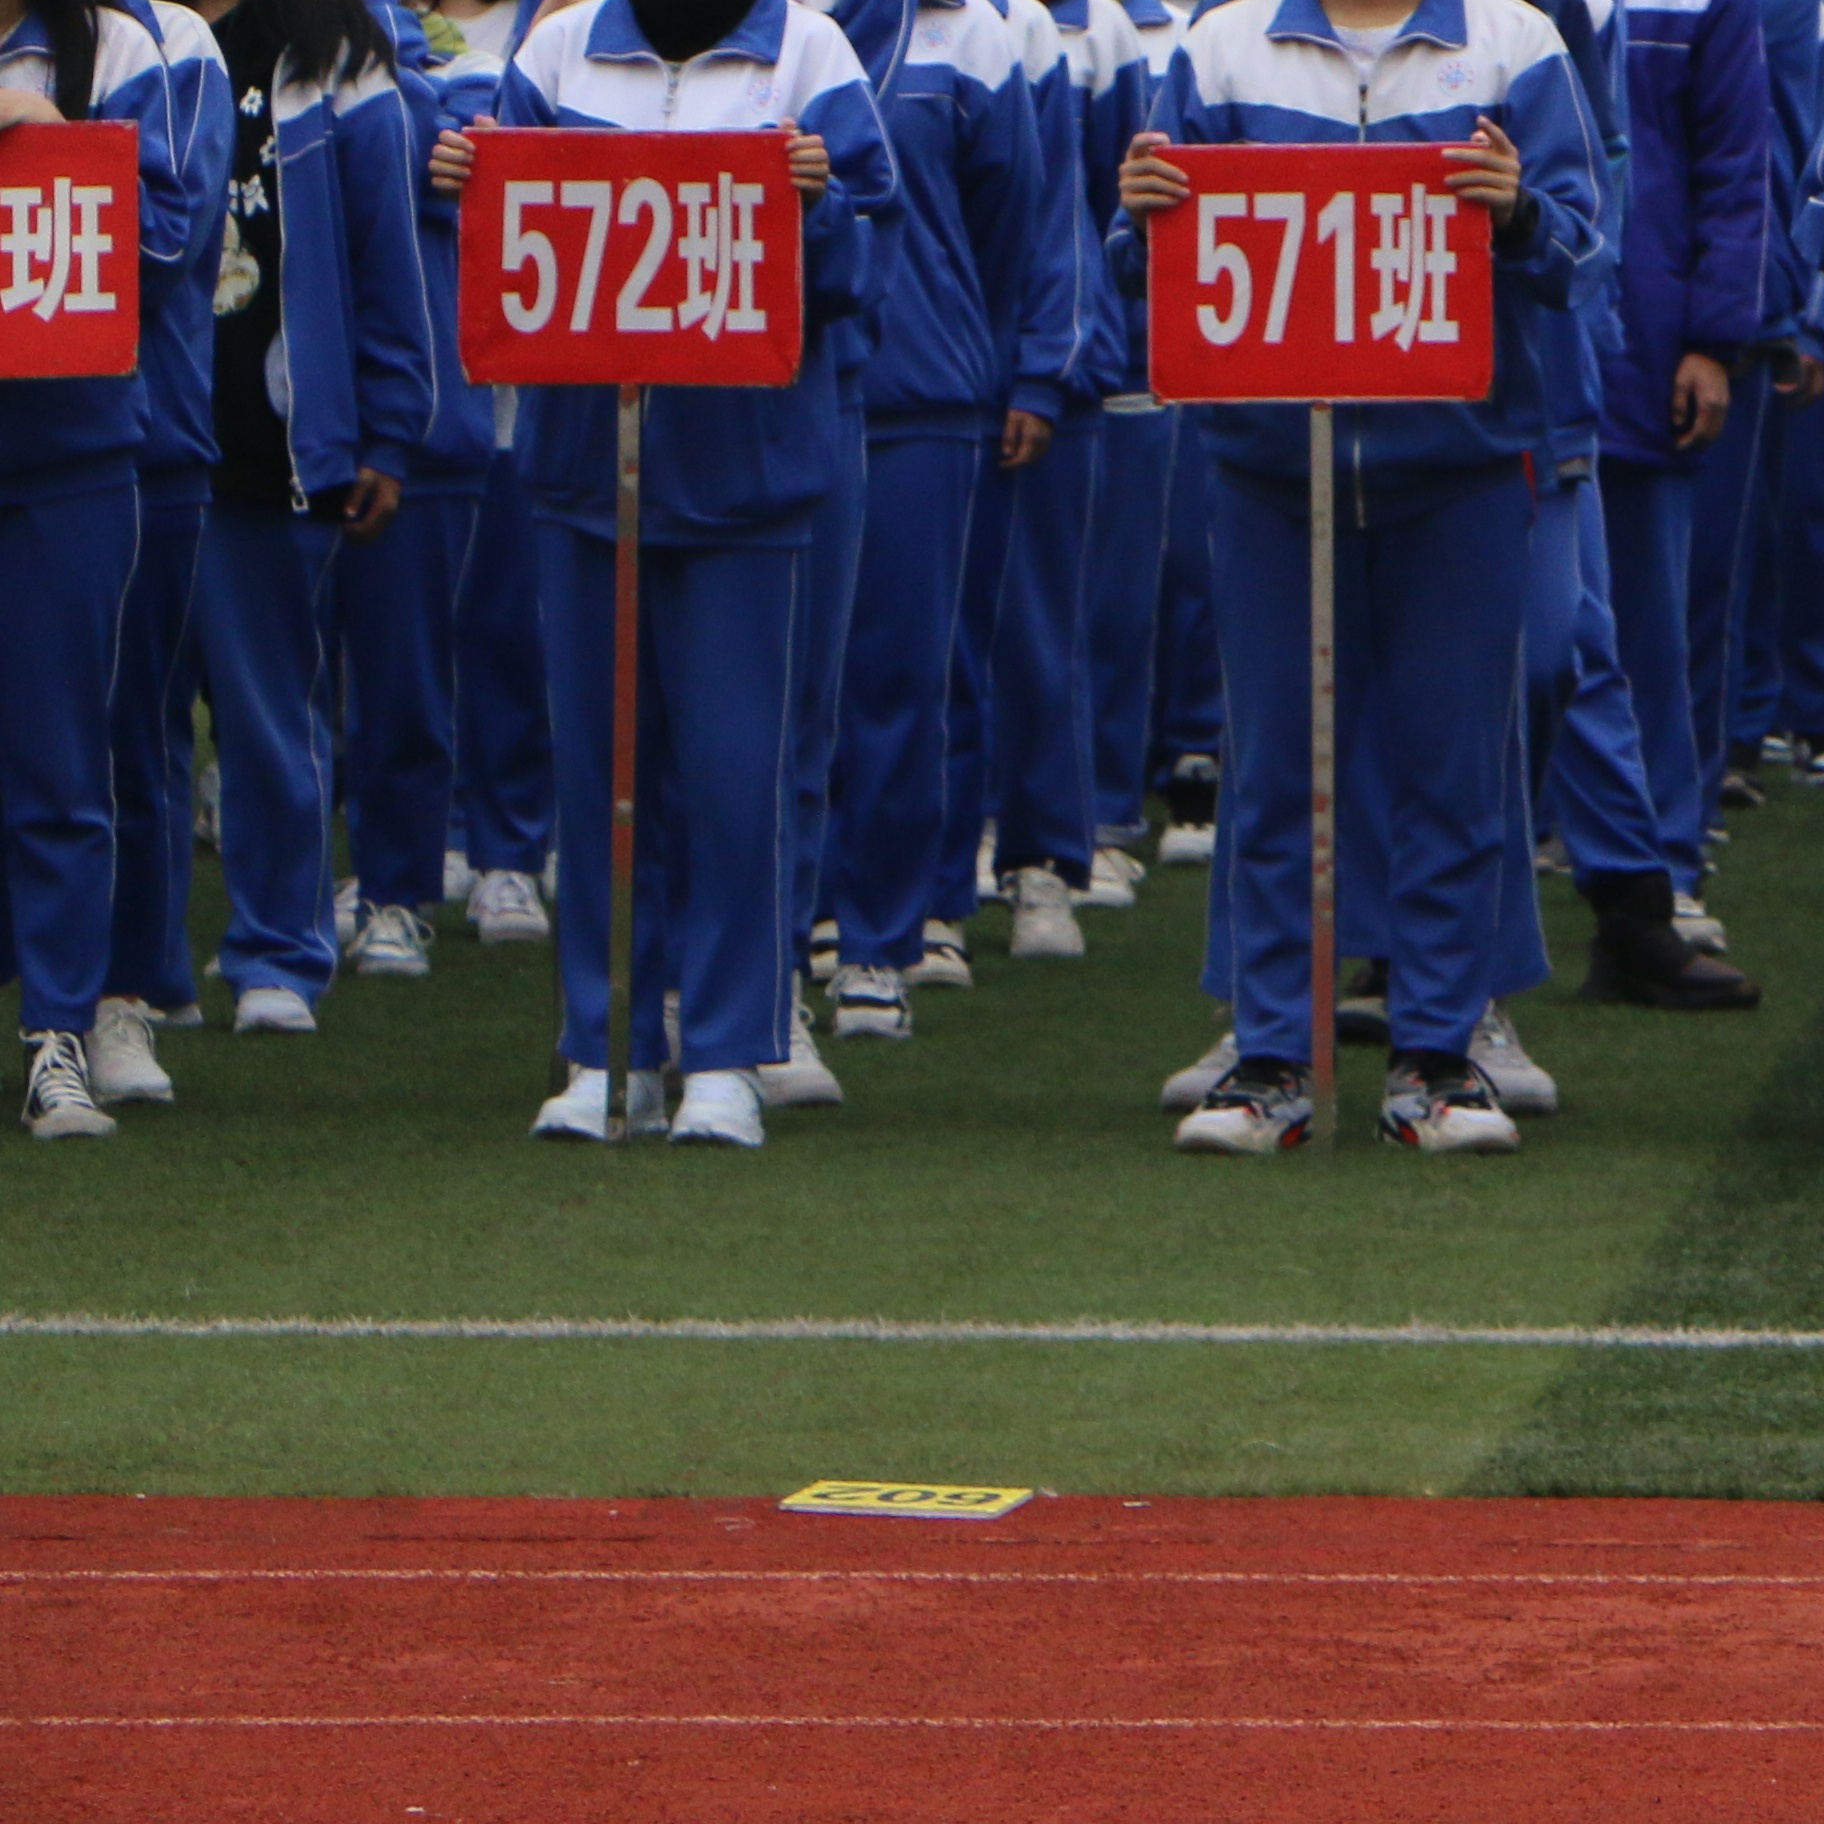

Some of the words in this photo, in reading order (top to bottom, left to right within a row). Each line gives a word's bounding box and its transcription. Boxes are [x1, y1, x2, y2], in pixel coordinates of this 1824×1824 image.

[503, 174, 766, 341] 572班
[1197, 184, 1458, 352] 571班
[811, 1485, 1003, 1507] 602
